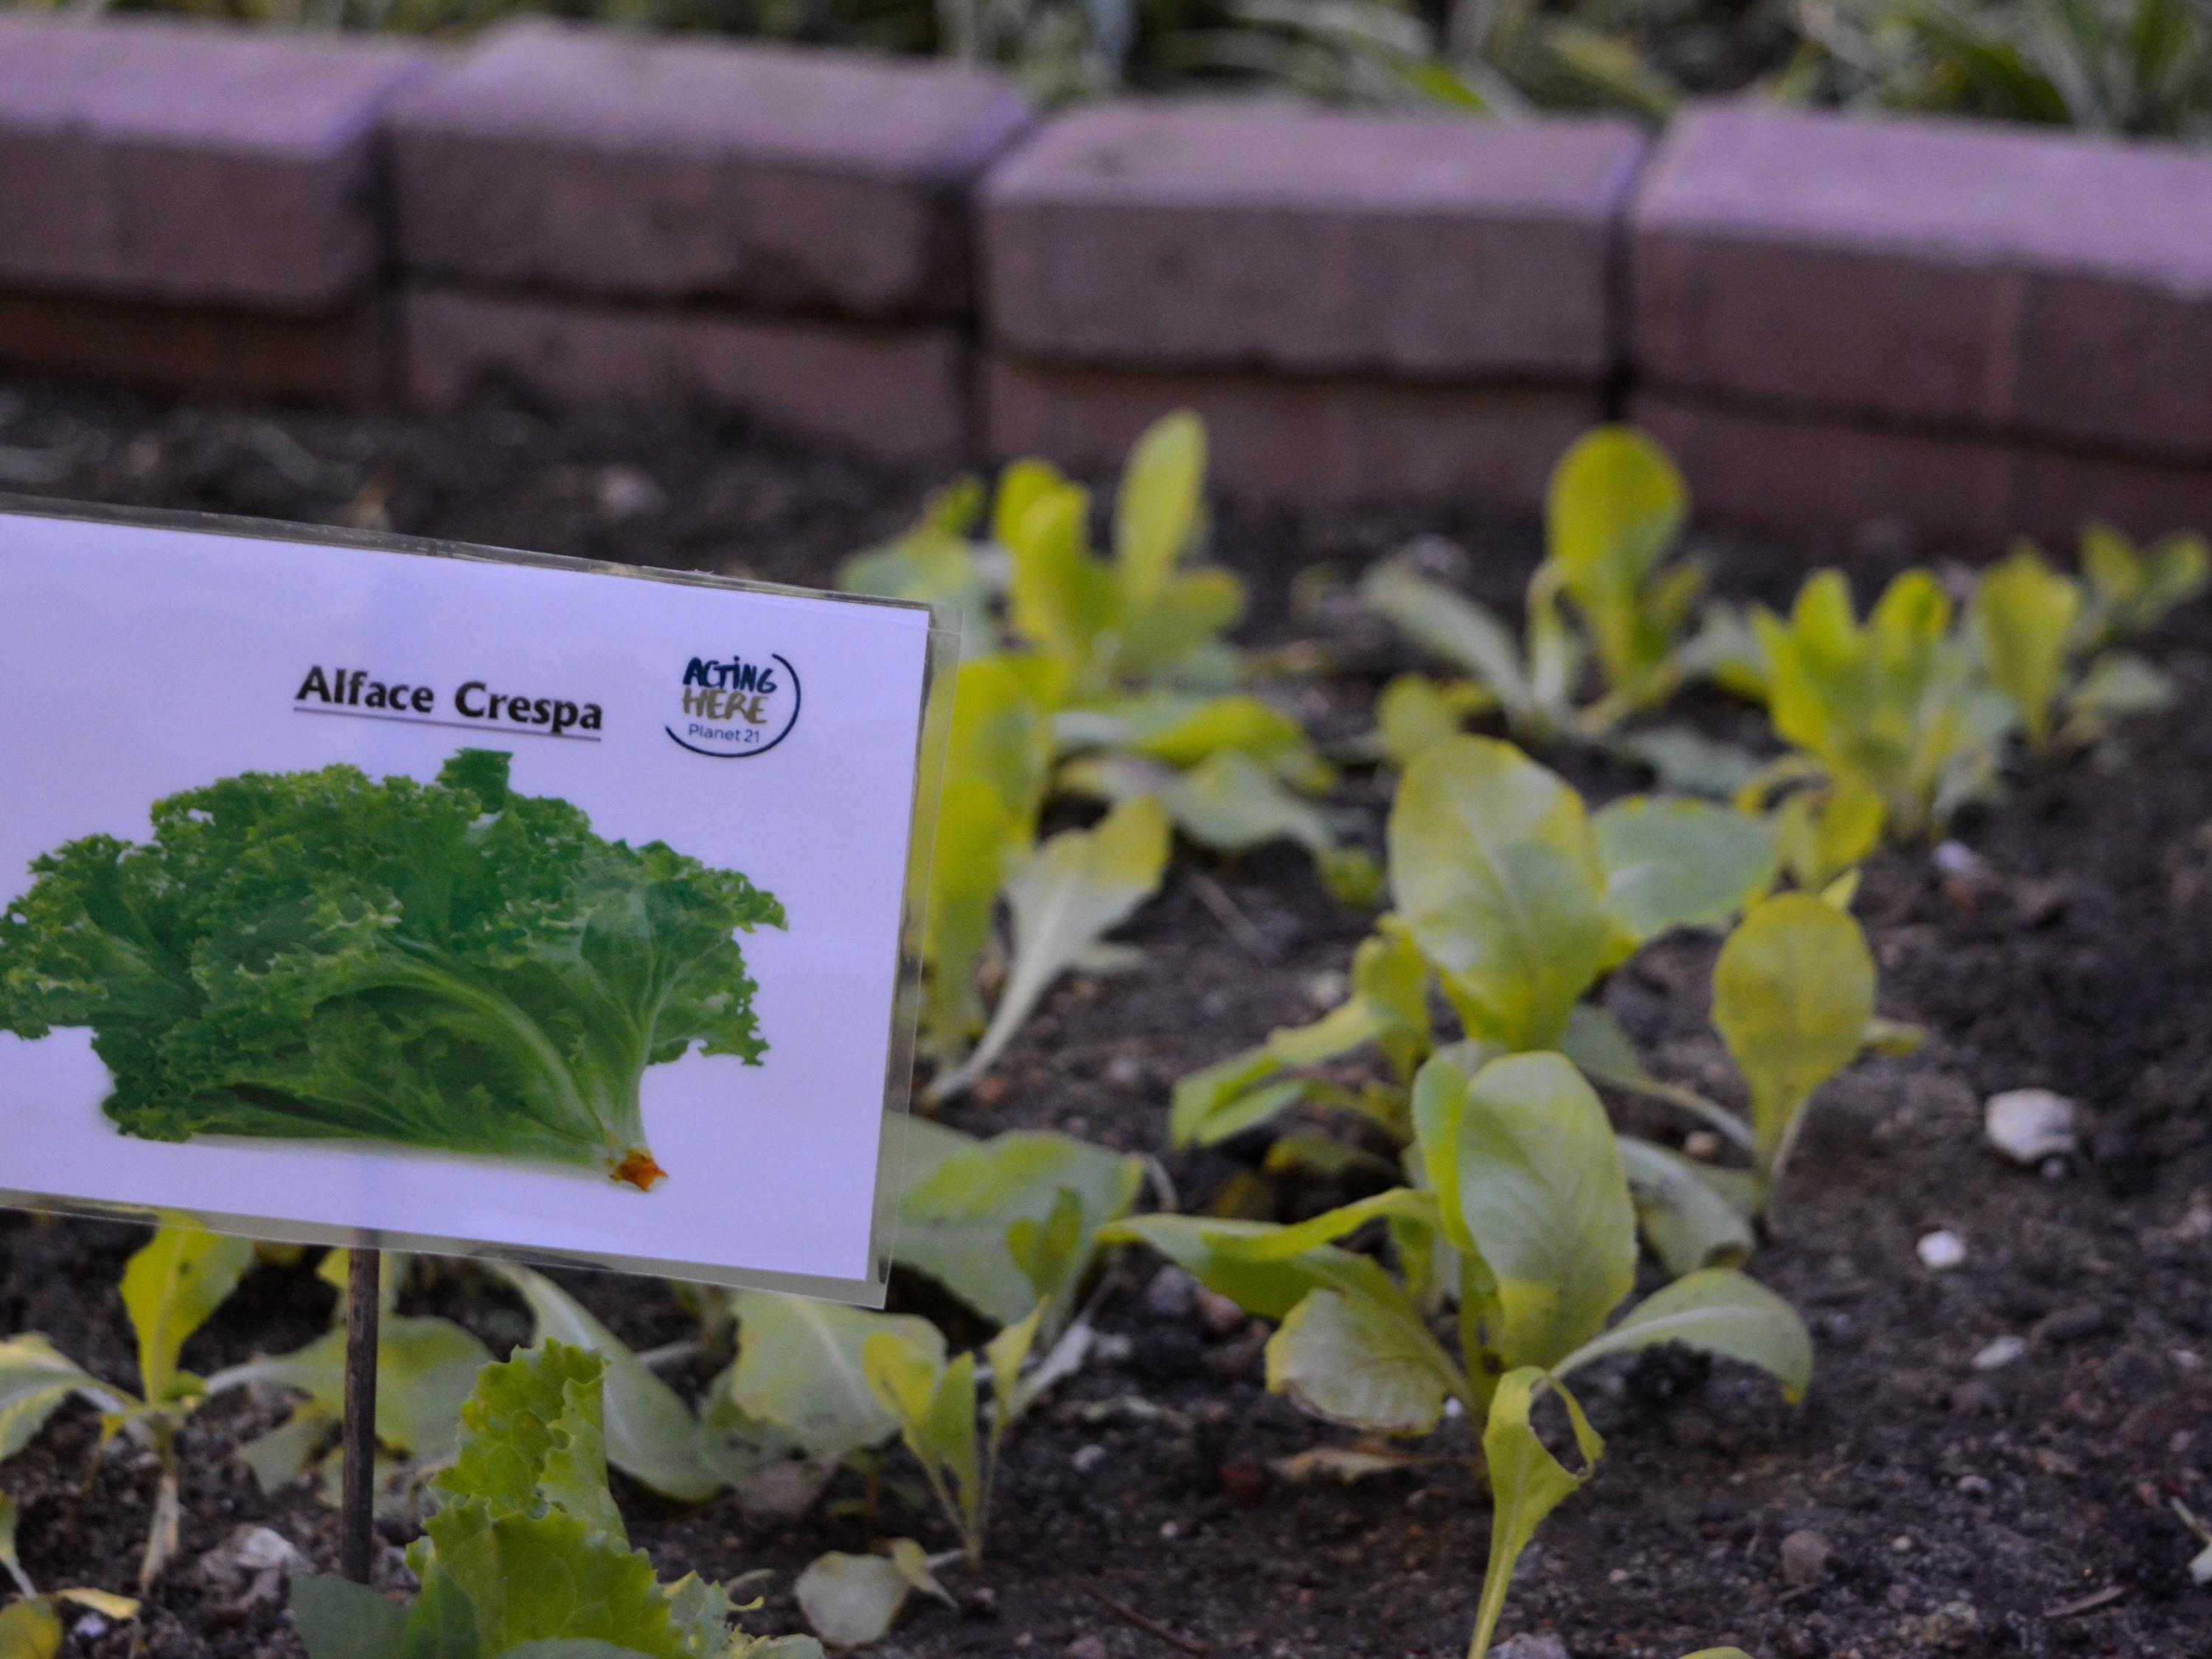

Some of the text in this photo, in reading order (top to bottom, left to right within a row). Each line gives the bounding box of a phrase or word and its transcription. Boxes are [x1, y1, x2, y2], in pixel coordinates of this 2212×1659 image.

[296, 664, 603, 734] Alface Crespa
[681, 686, 770, 725] HERE
[688, 723, 760, 743] Planet 21
